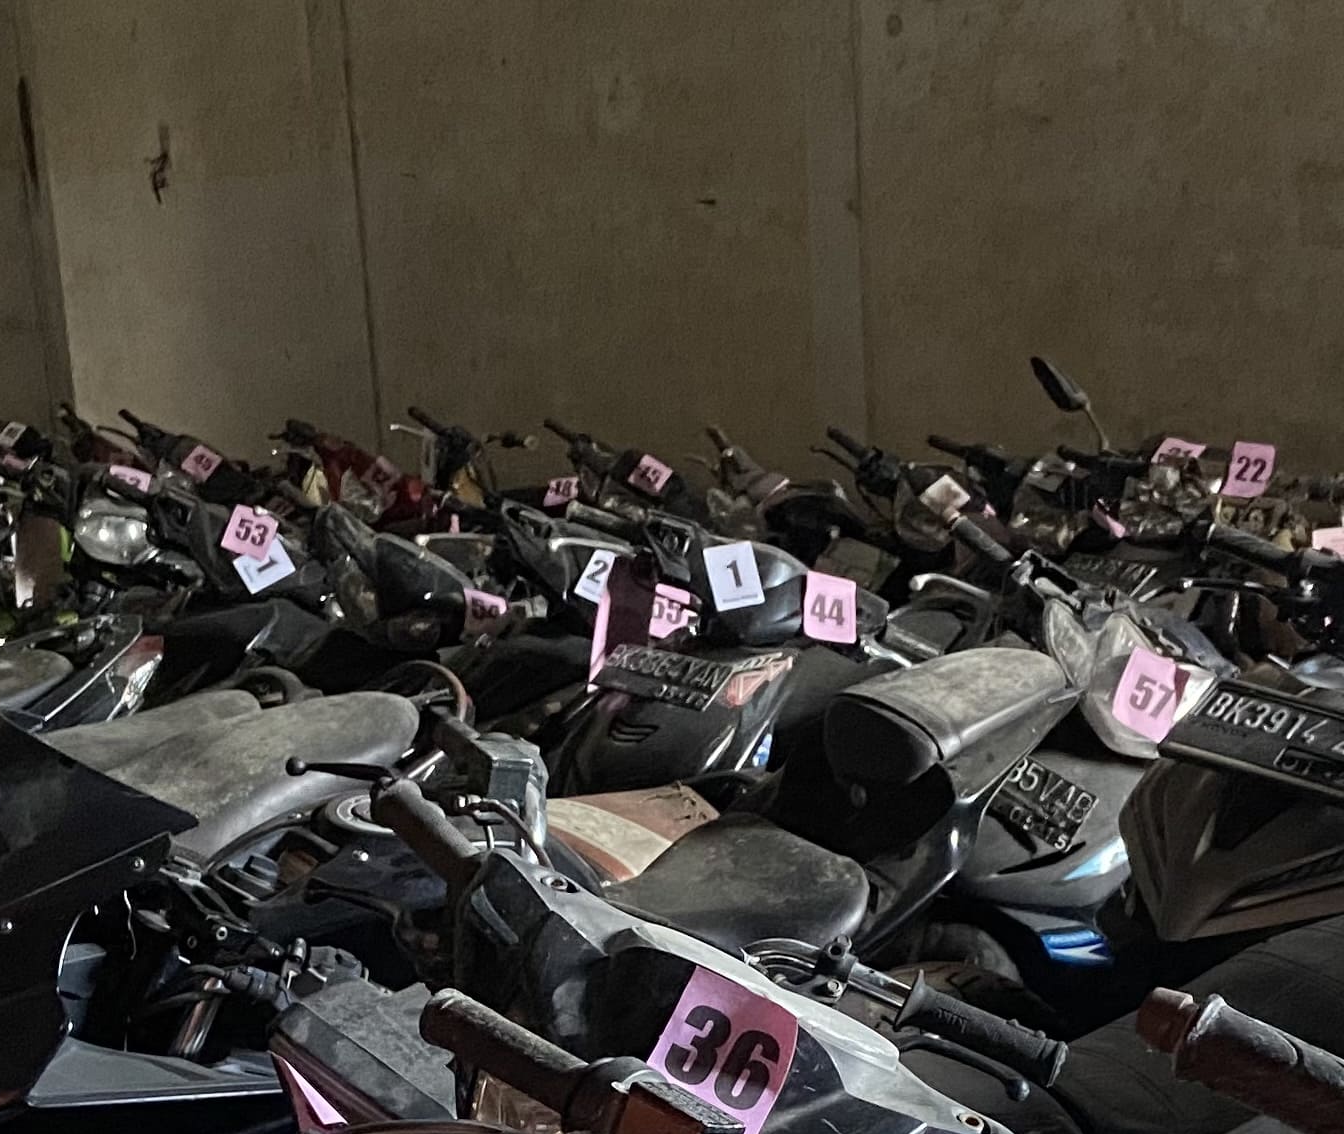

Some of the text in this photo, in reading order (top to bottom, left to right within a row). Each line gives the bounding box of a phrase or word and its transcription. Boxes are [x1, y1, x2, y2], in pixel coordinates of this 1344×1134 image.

[1235, 455, 1267, 484] 22
[234, 518, 268, 548] 53
[586, 559, 609, 584] 2
[726, 560, 743, 588] 1
[809, 595, 846, 627] 44
[1128, 679, 1174, 722] 57
[663, 1004, 782, 1111] 36
